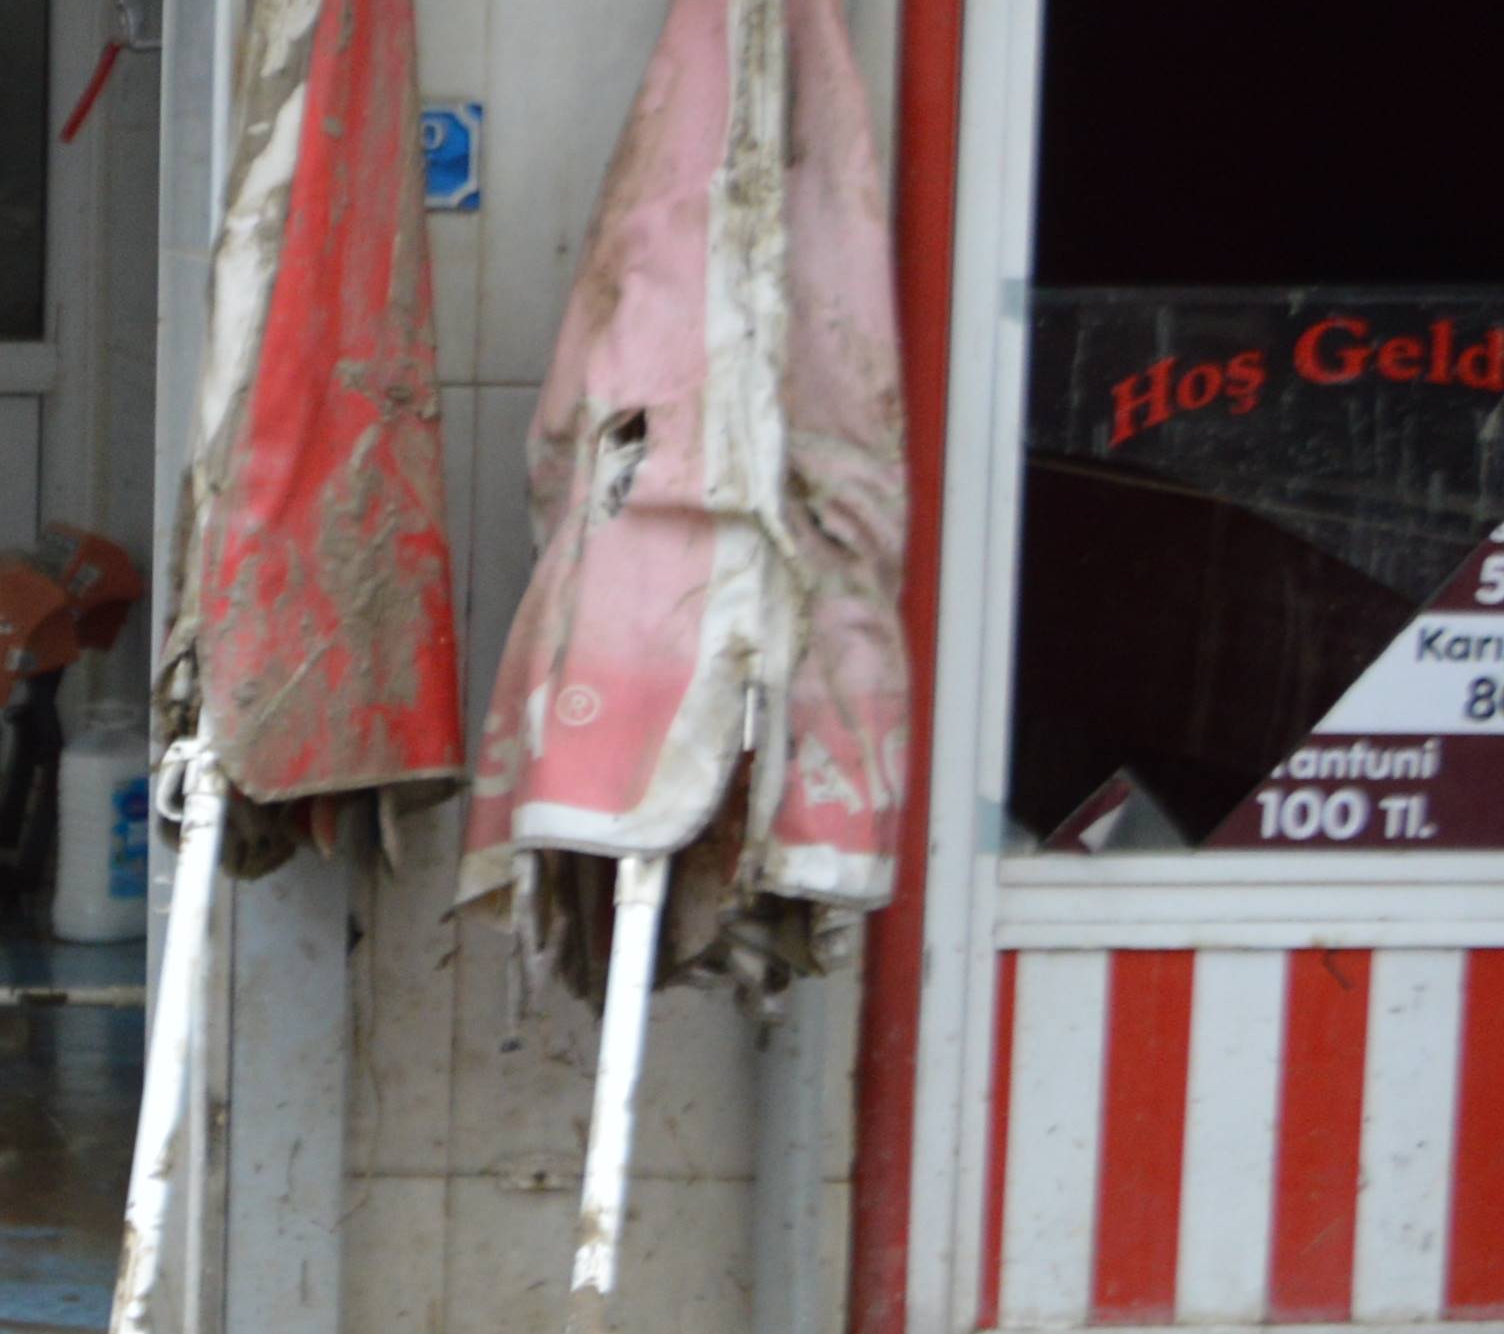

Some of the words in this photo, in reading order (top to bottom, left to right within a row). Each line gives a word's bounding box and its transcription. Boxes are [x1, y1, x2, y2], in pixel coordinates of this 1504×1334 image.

[1108, 349, 1267, 449] Hoş
[1463, 674, 1504, 723] 8
[1255, 785, 1371, 841] 100
